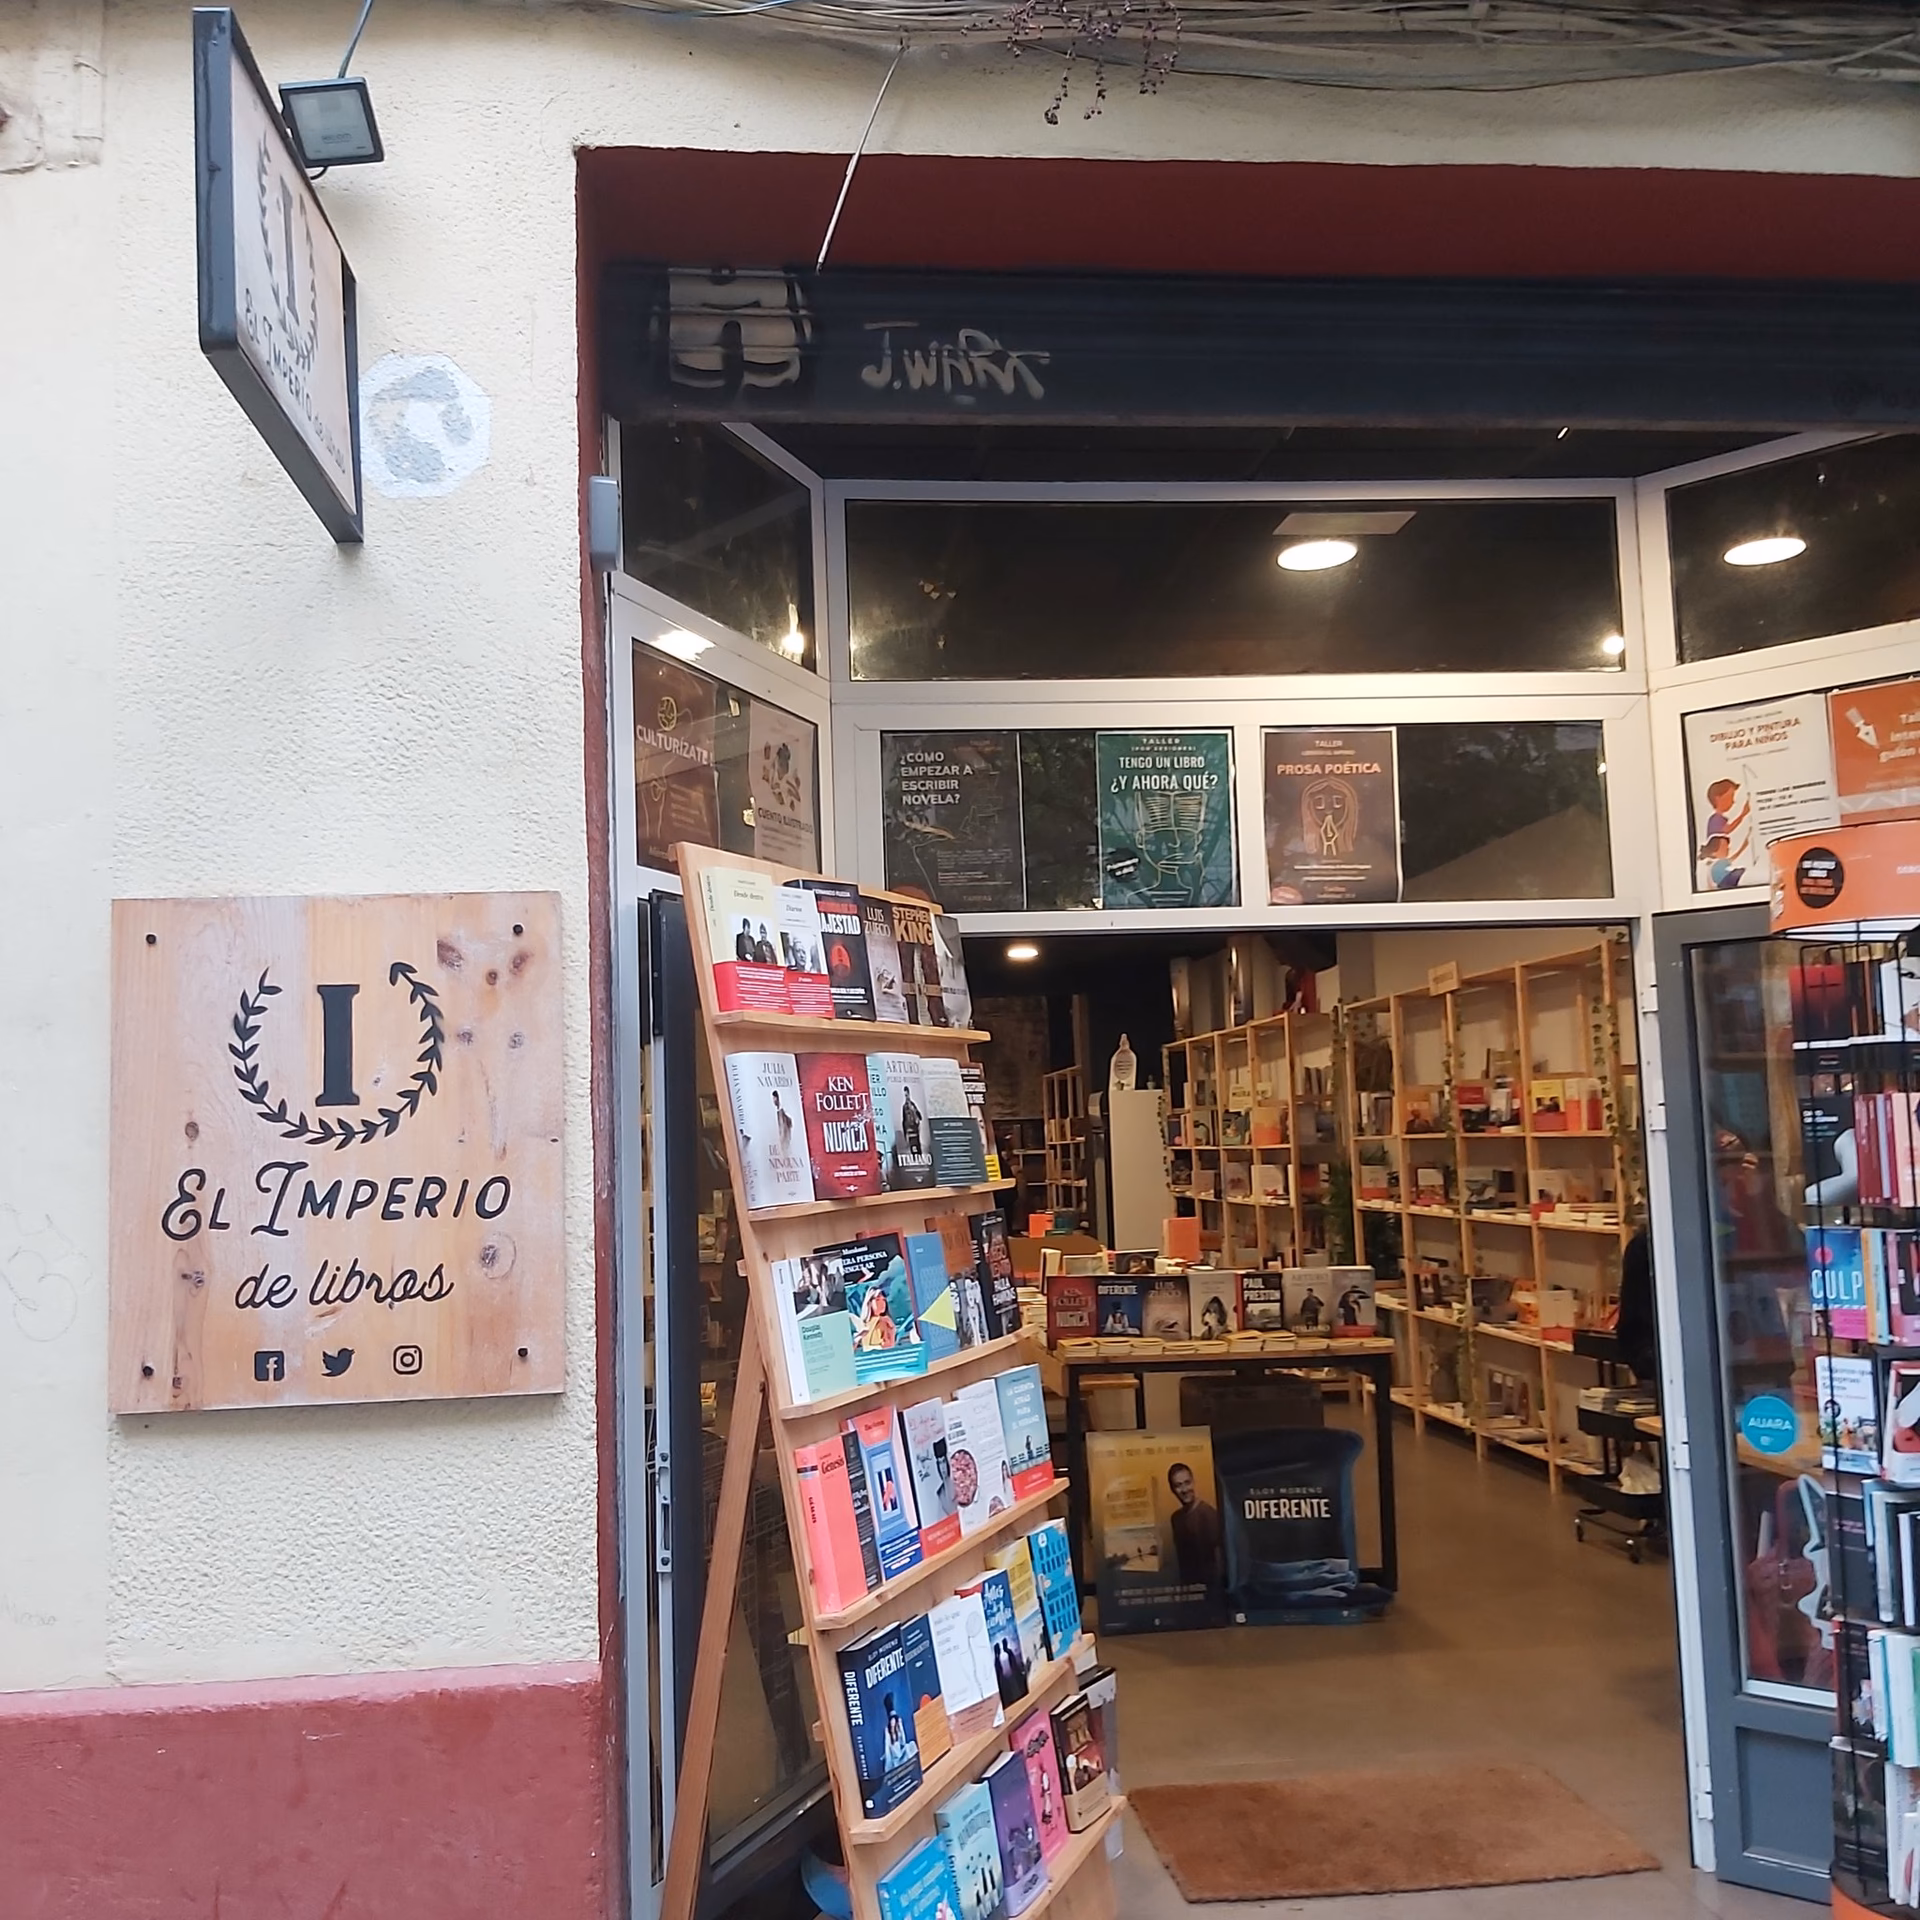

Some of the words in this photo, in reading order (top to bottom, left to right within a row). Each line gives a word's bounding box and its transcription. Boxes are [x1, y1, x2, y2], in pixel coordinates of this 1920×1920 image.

[1709, 729, 1746, 743] DIBUJO
[1757, 718, 1800, 732] PINTURA
[1725, 739, 1753, 750] PARA
[1119, 757, 1152, 769] TENGO
[1156, 757, 1171, 768] UN
[1174, 756, 1205, 769] LIBRO
[1277, 764, 1322, 775] PROSA
[1325, 761, 1382, 774] POÉTICA
[901, 765, 960, 777] EMPEZAR
[963, 767, 973, 775] A
[901, 780, 960, 791] ESCRIBIR
[1110, 775, 1128, 793] ¿Y
[1132, 775, 1179, 790] AHORA
[1183, 770, 1219, 791] QUÉ?
[902, 794, 961, 806] NOVELA?
[867, 906, 884, 921] LUIS
[895, 920, 933, 945] KING
[762, 1062, 786, 1075] JULIA
[886, 1060, 919, 1074] ARTURO
[828, 1076, 854, 1092] KEN
[815, 1092, 868, 1112] FOLLETT
[823, 1119, 868, 1152] NUNCA
[897, 1153, 933, 1167] ITALIANO
[776, 1171, 800, 1183] PARTE
[856, 1251, 888, 1263] PERSONA
[236, 1263, 298, 1309] de
[309, 1258, 454, 1306] libros
[1098, 1285, 1139, 1295] DIFERENTE
[1243, 1278, 1265, 1289] PAUL
[1812, 1269, 1864, 1300] CULP
[1244, 1290, 1281, 1301] PRESTON
[1244, 1498, 1331, 1519] DIFERENTE
[865, 1647, 905, 1689] DIFERENTE
[844, 1671, 864, 1726] DIFERENTE
